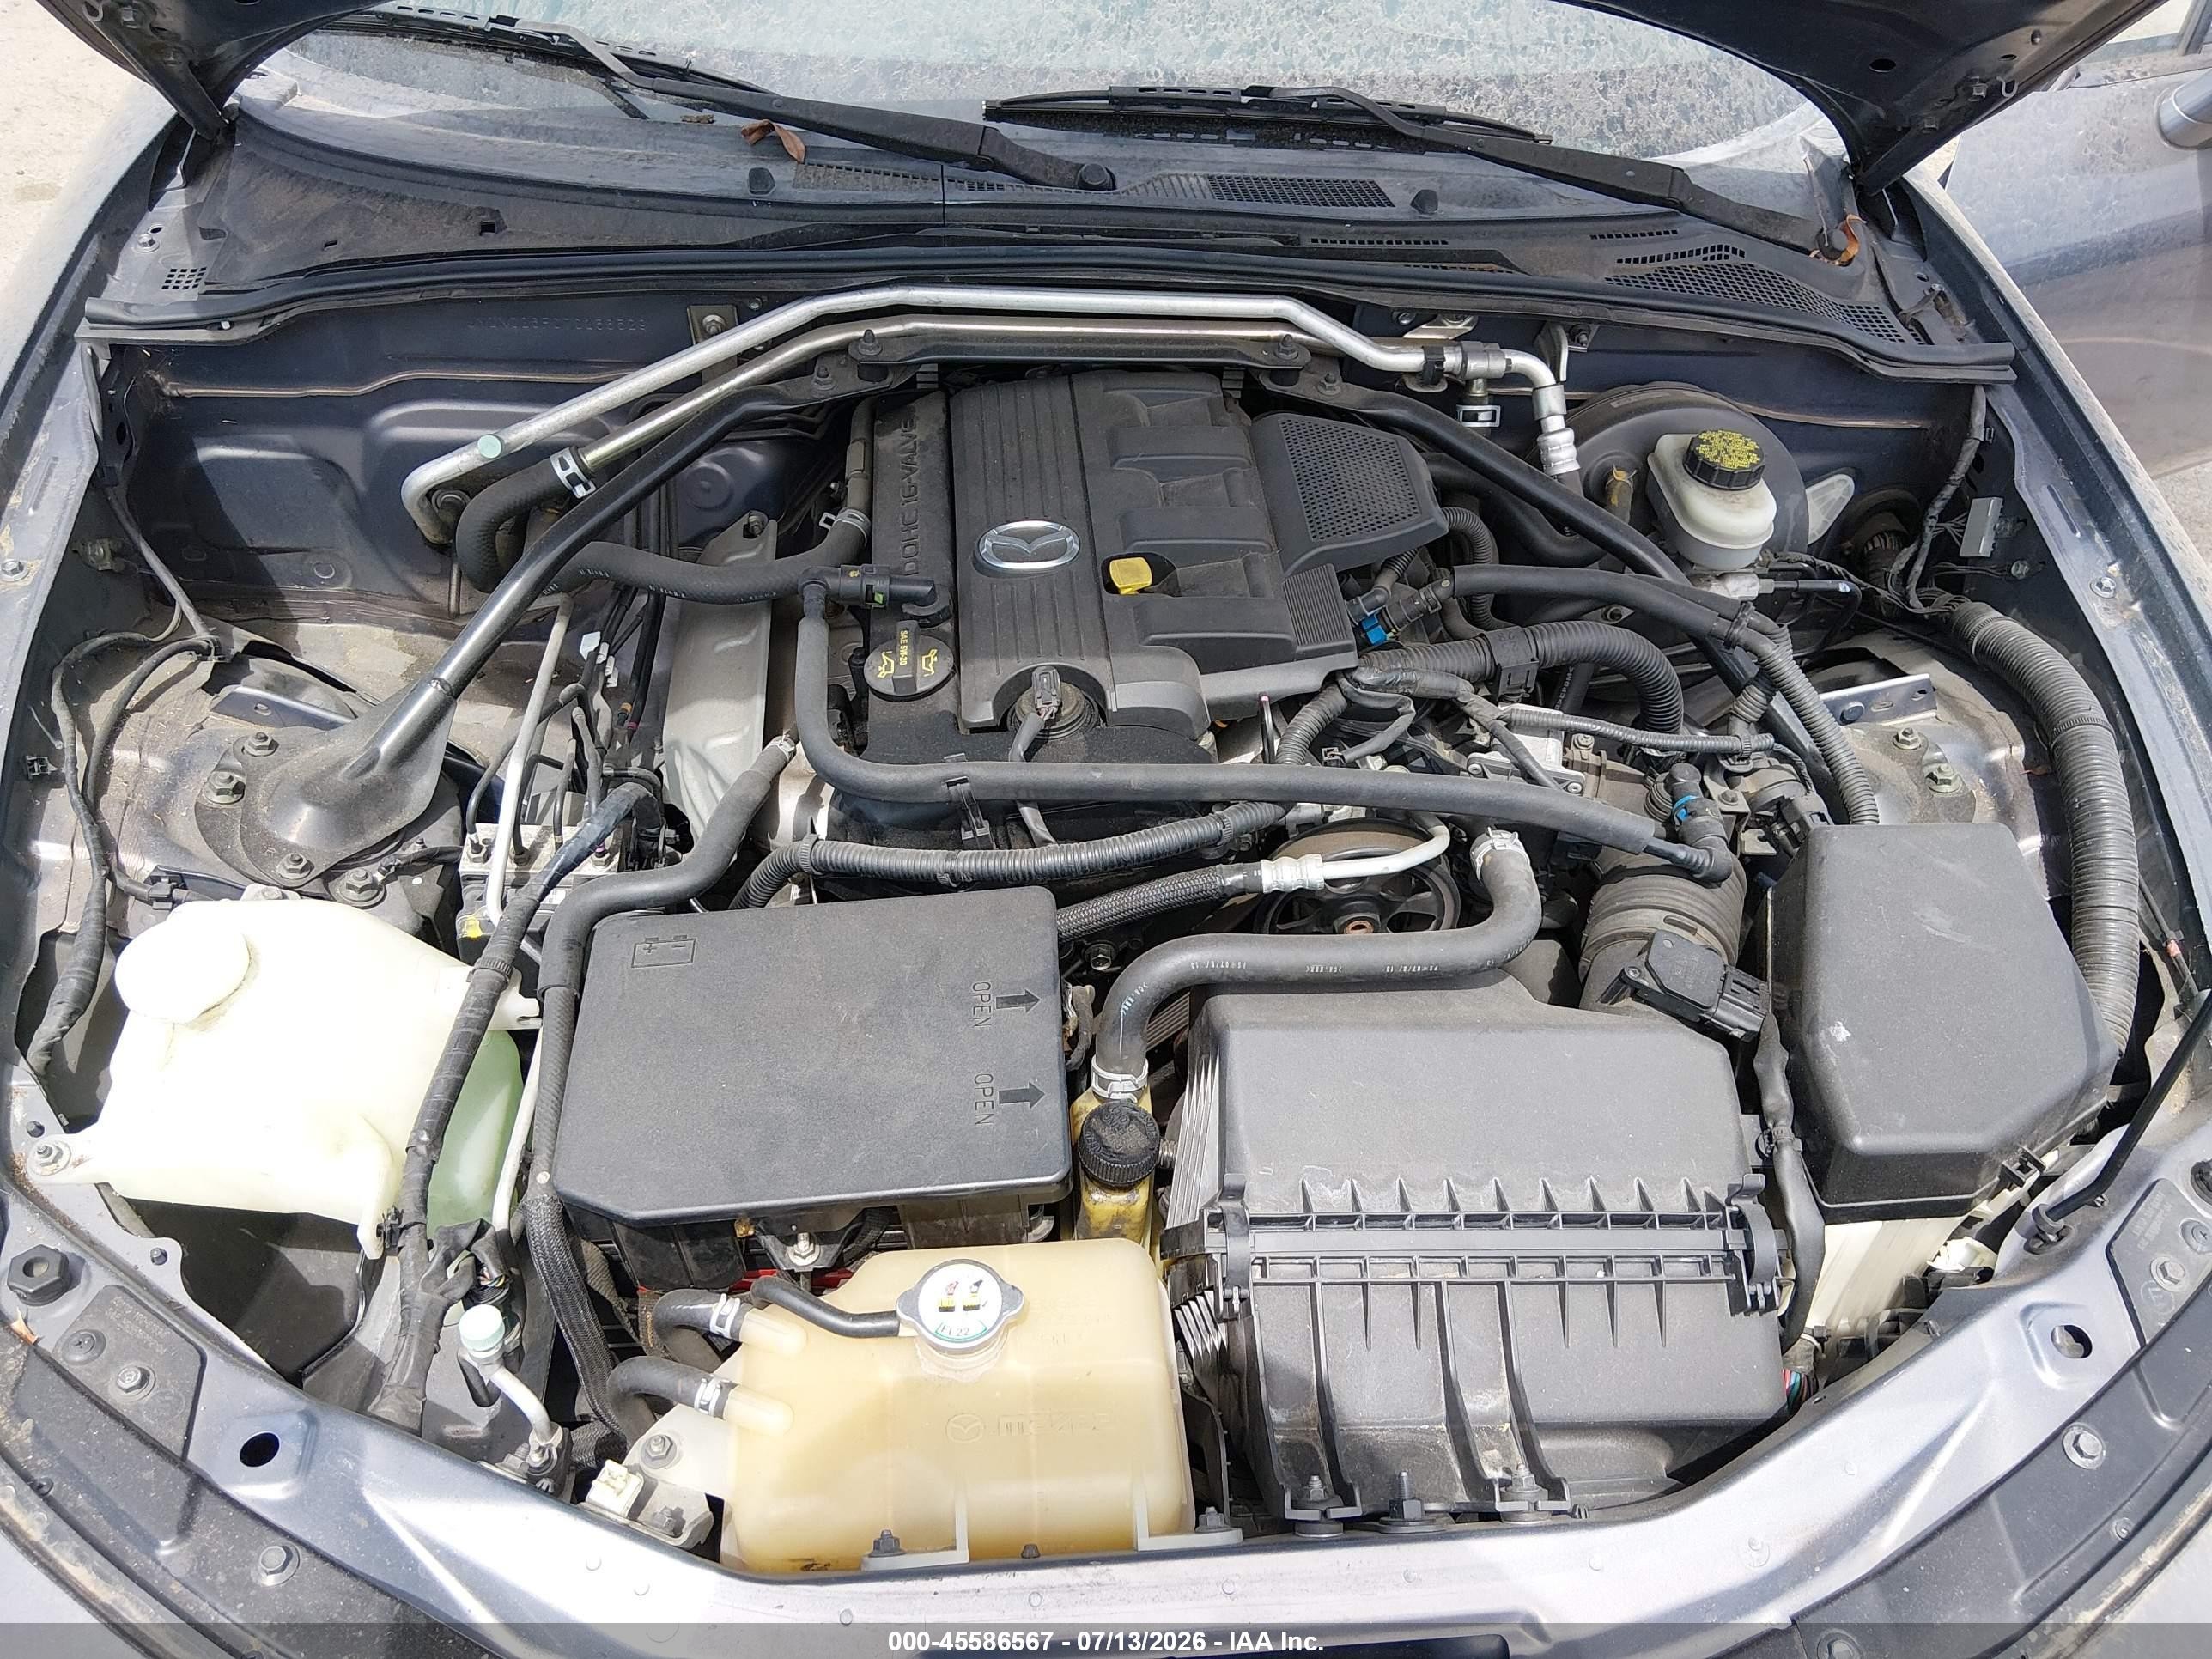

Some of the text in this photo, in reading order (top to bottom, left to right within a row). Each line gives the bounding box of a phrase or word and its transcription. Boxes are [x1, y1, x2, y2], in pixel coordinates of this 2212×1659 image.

[901, 507, 919, 577] DOHC
[898, 629, 909, 665] SAE 5W-20
[972, 981, 992, 1028] OPEN
[974, 1073, 994, 1126] OPEN
[940, 1324, 971, 1337] FL22
